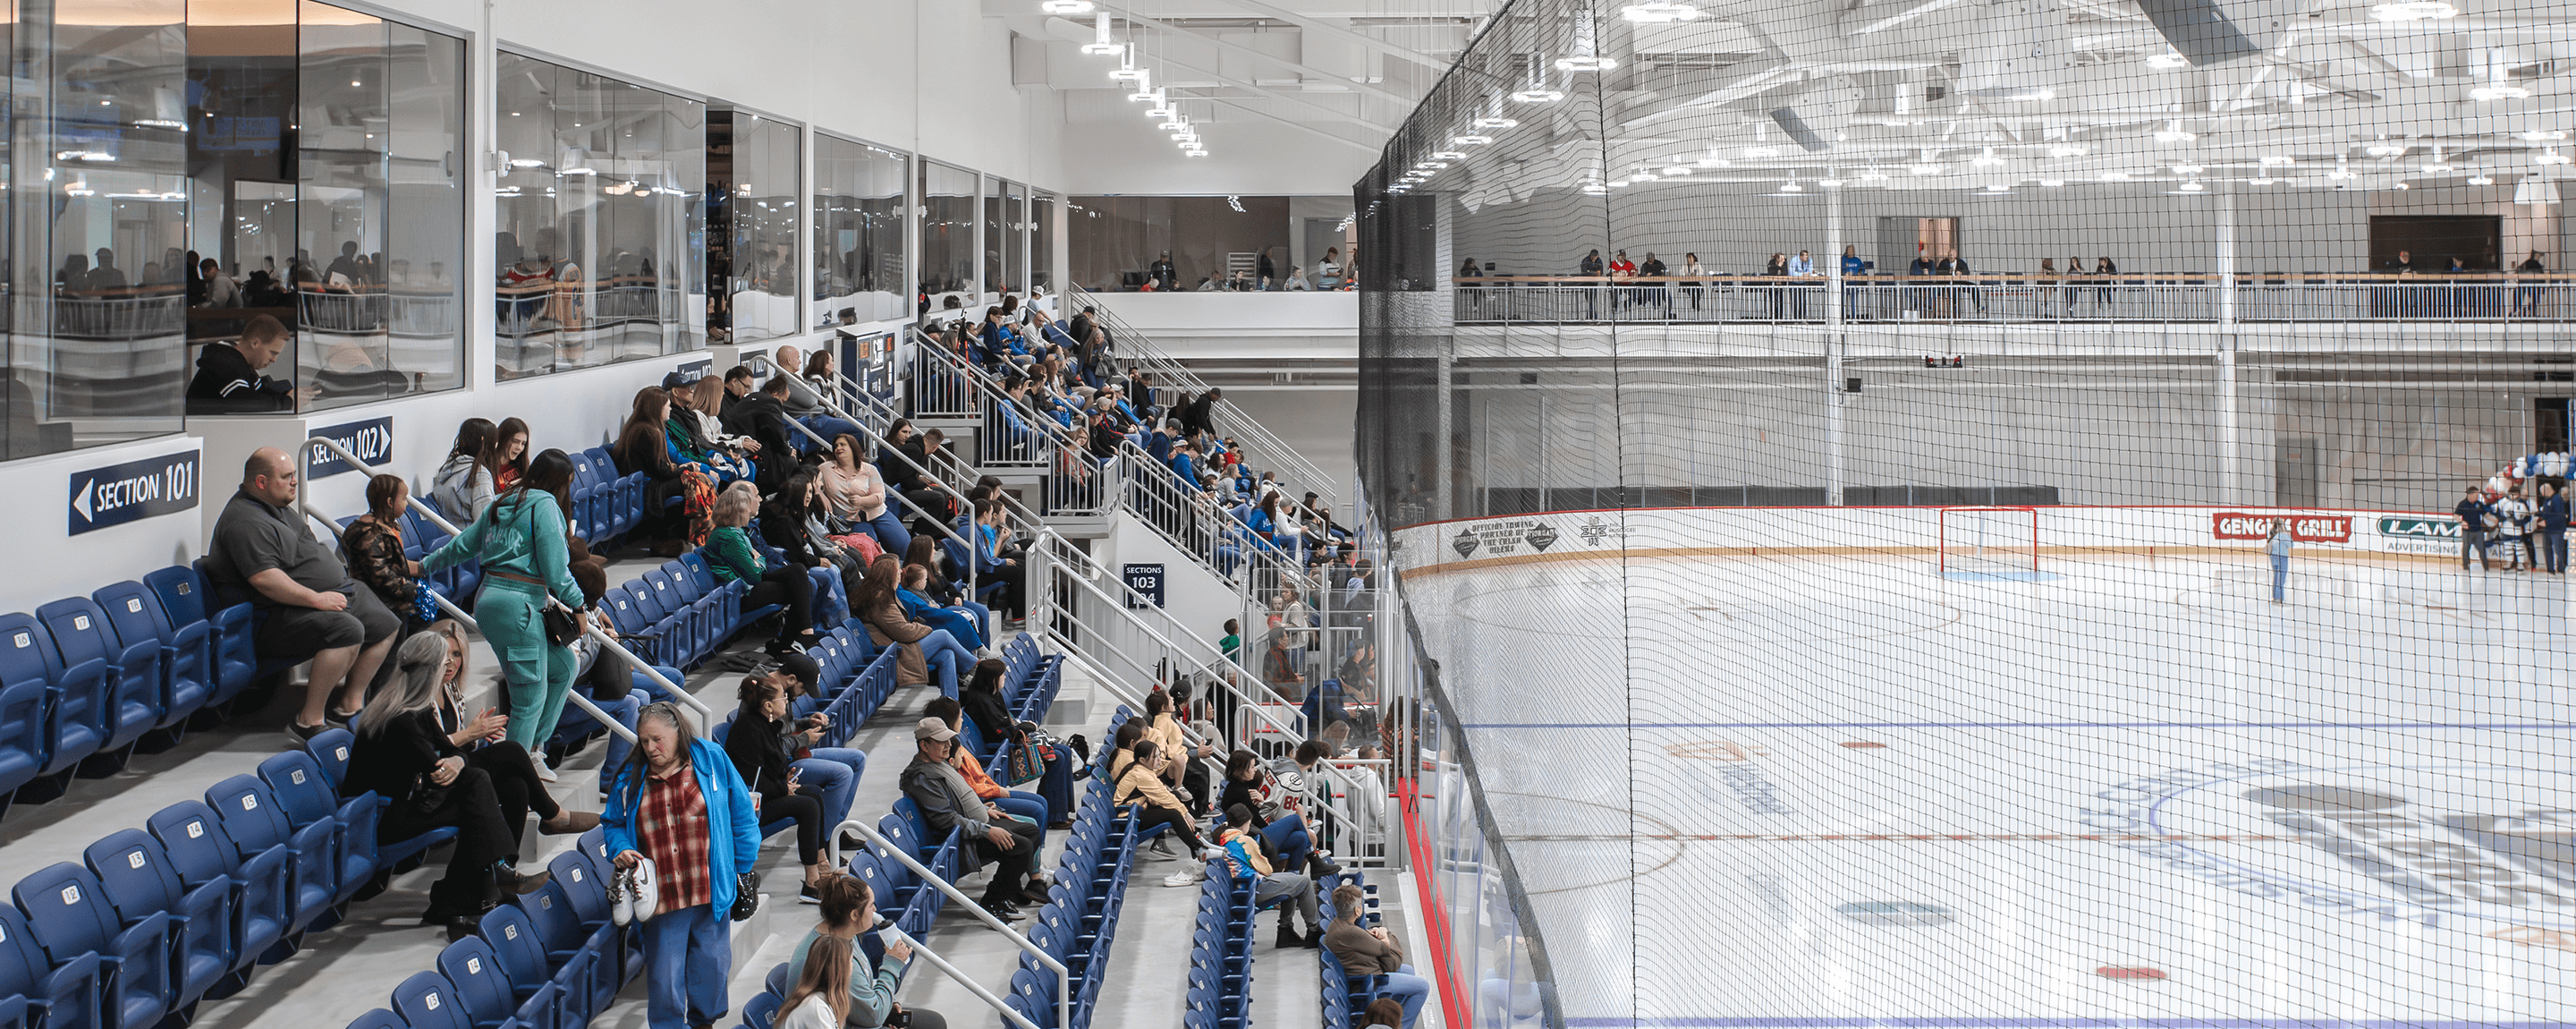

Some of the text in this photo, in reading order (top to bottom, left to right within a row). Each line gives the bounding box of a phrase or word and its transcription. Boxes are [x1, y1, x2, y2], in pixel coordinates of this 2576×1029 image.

[357, 427, 378, 461] 102
[97, 461, 193, 513] SECTION 101
[1471, 521, 1535, 532] OFFICIAL TOWING
[2219, 517, 2345, 538] GENGHS GRILL
[1480, 529, 1524, 540] PARTNER OF
[1484, 537, 1521, 547] THE TULSA
[2387, 542, 2459, 555] ADVERTISING
[1132, 577, 1156, 589] 103
[130, 600, 140, 611] 18
[77, 617, 88, 628] 17
[17, 634, 28, 645] 16
[338, 749, 347, 760] 17
[293, 772, 304, 783] 16
[244, 797, 257, 809] 15
[189, 823, 201, 836] 14
[130, 853, 143, 867] 13
[64, 888, 79, 902] 12
[541, 897, 551, 908] 16
[506, 926, 516, 938] 15
[469, 959, 479, 971] 14
